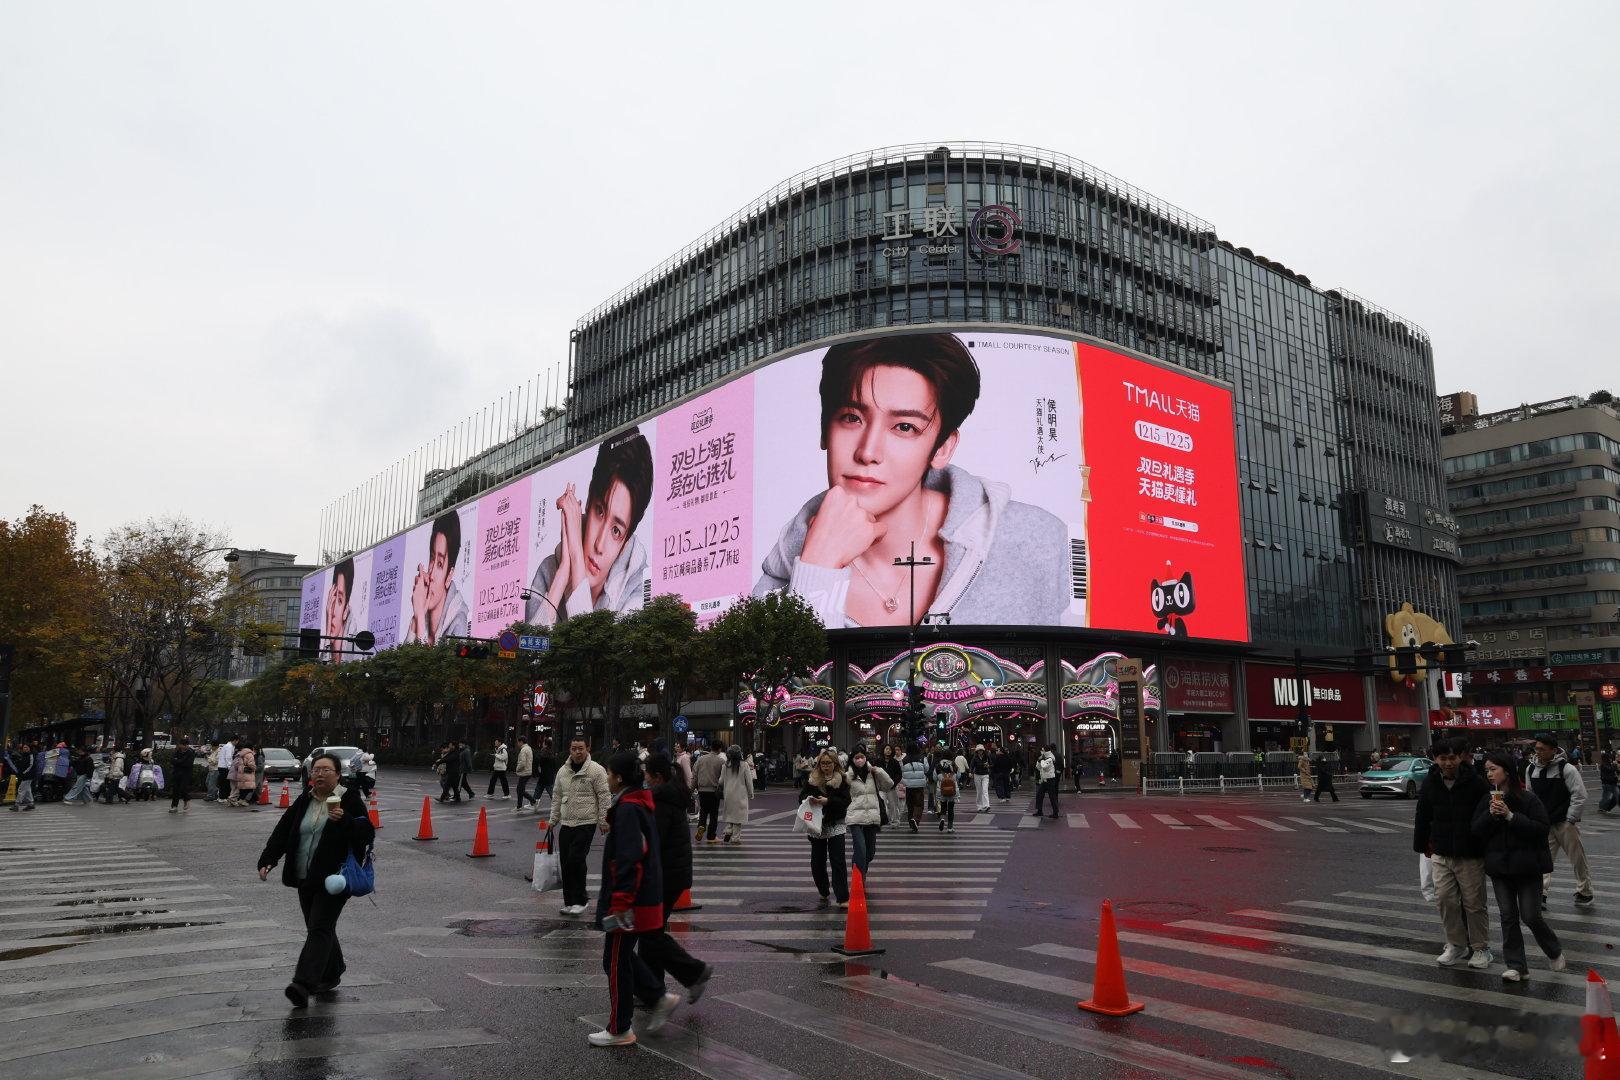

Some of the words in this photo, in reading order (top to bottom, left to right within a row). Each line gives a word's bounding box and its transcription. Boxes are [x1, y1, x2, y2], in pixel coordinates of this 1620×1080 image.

[882, 244, 909, 258] City
[918, 244, 960, 255] Center
[977, 341, 1002, 349] TMALL
[1003, 342, 1044, 352] COURTESY
[1044, 344, 1070, 355] SEASON
[669, 432, 737, 477] 双旦上淘宝
[666, 457, 738, 502] 爱在心选礼
[1136, 456, 1195, 486] 双旦礼遇季
[1138, 477, 1198, 507] 天猫更懂礼
[922, 688, 952, 700] INISO
[953, 685, 978, 700] LAND
[1313, 686, 1342, 701] 無印良品
